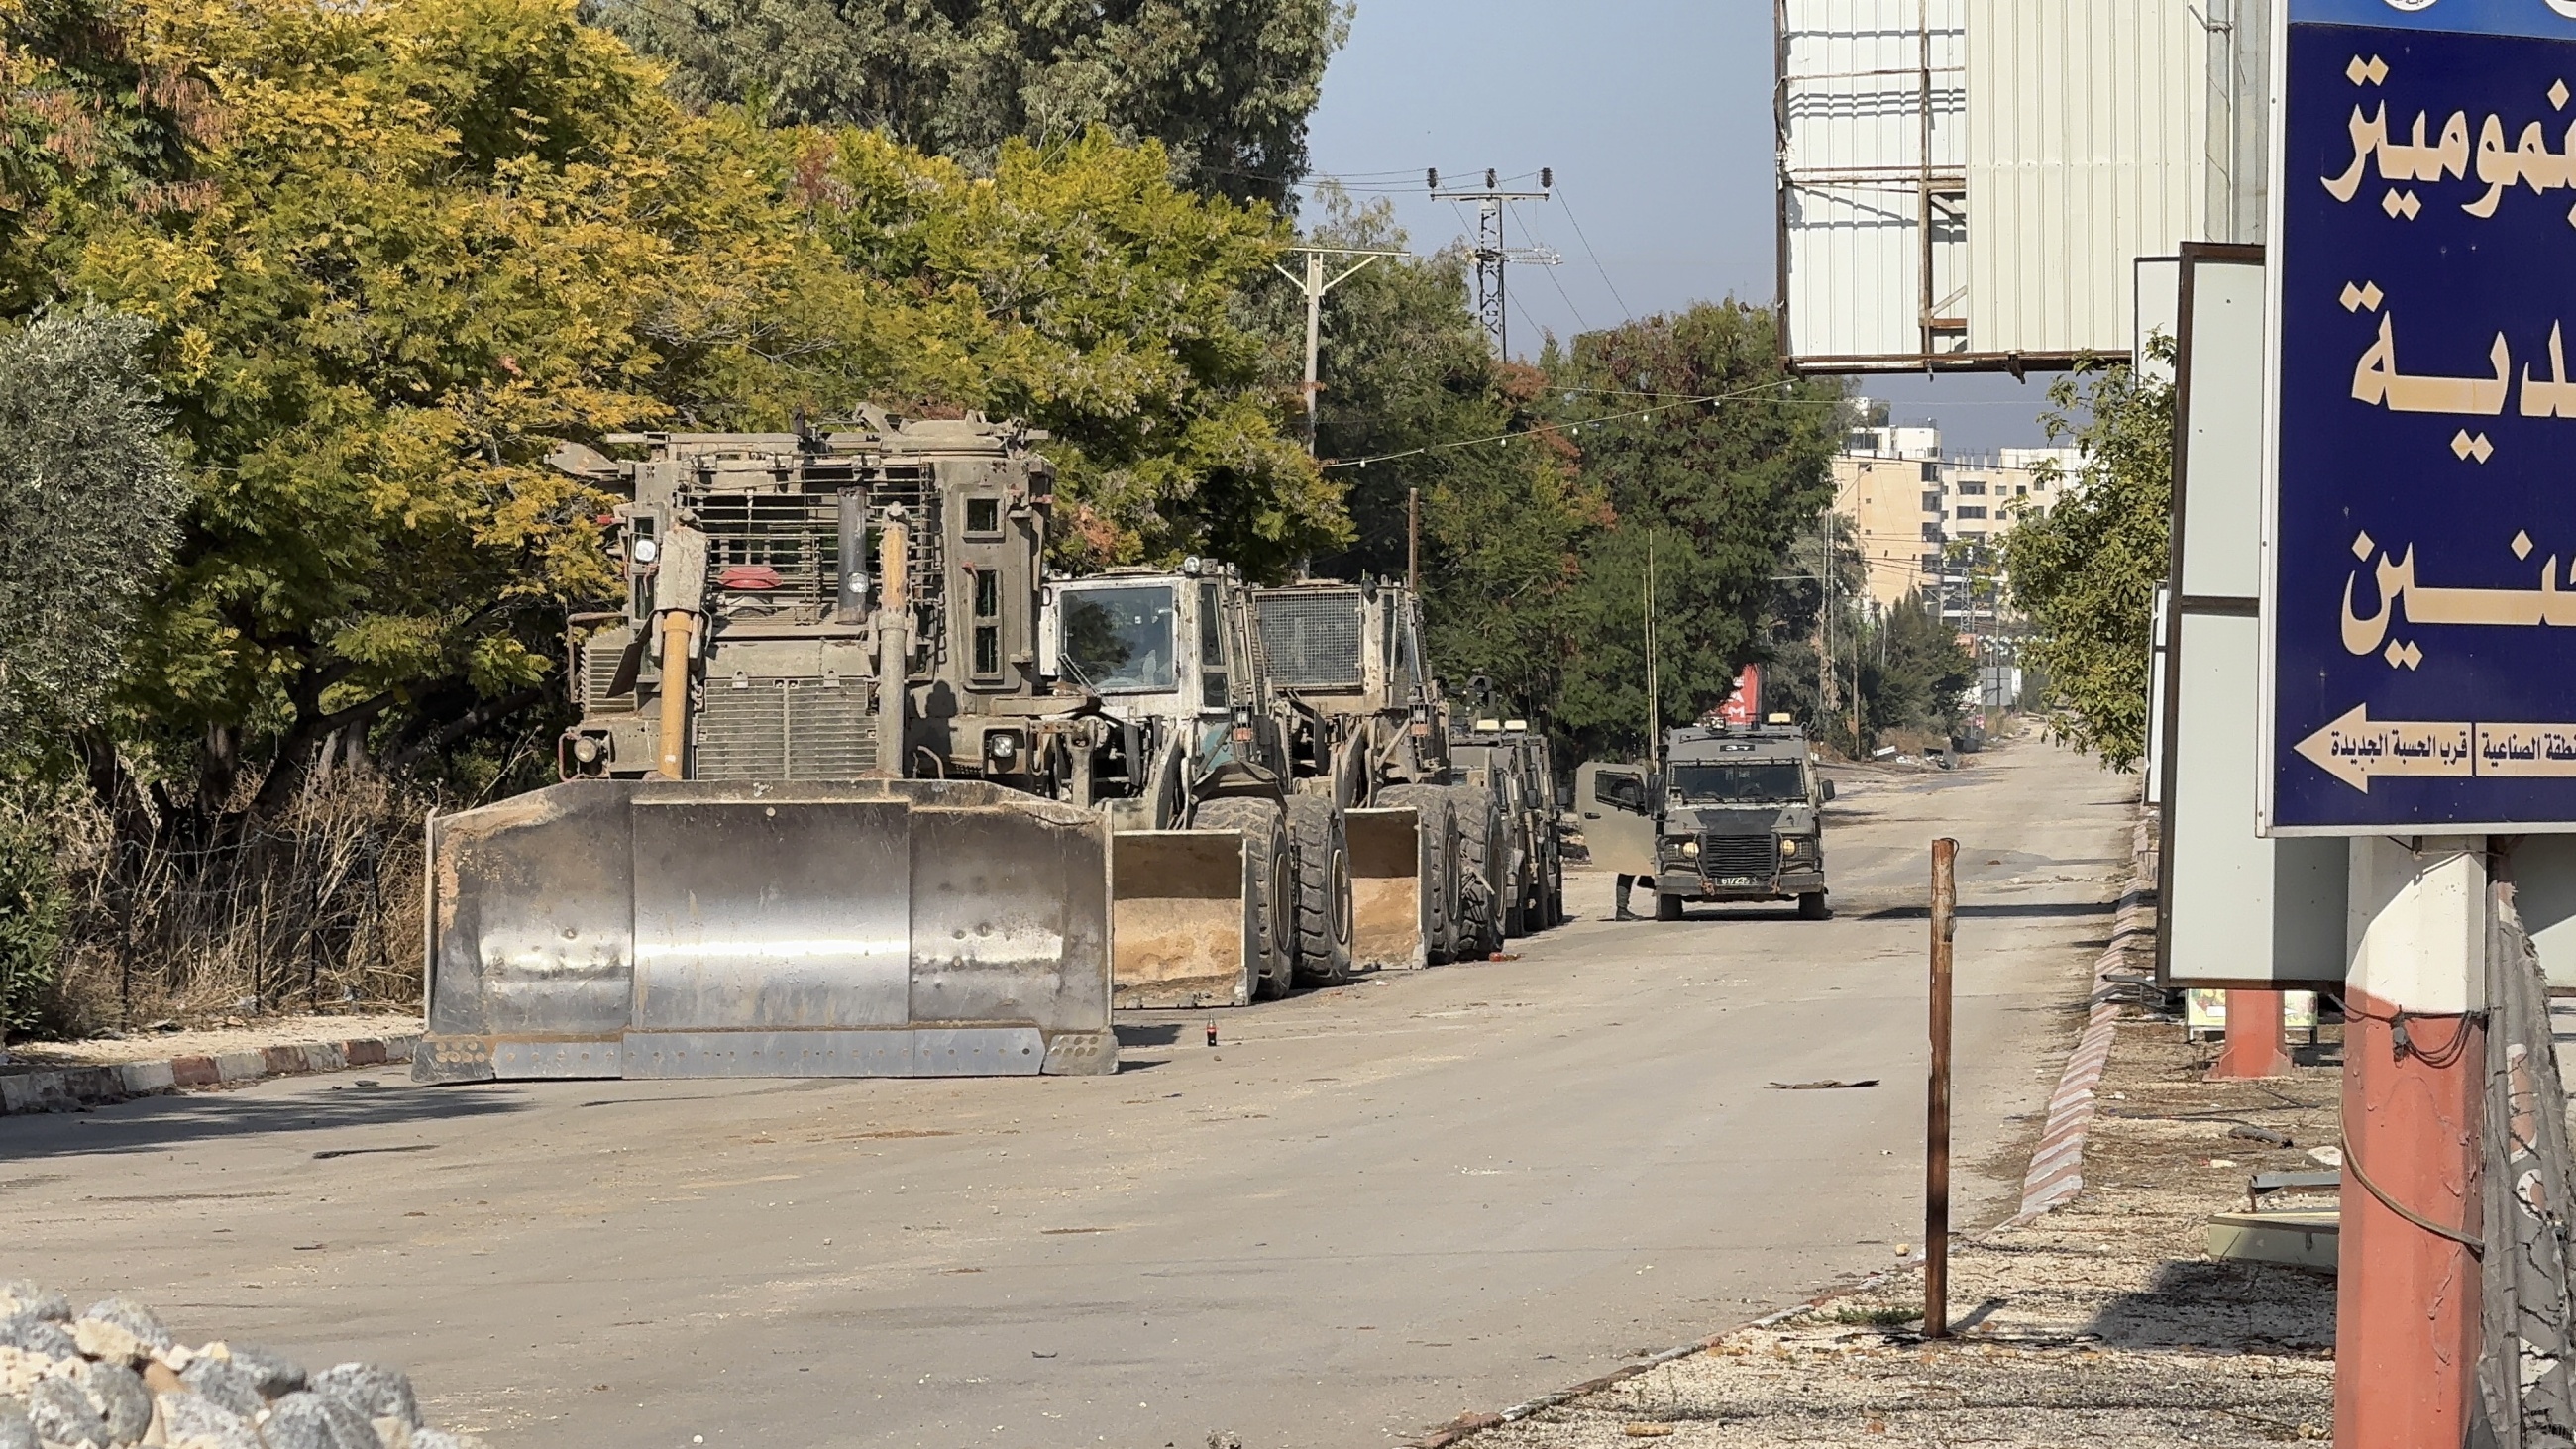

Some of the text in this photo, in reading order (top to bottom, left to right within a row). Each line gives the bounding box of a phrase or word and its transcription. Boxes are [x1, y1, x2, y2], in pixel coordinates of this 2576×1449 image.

[2340, 529, 2576, 672] نين
[2330, 730, 2389, 766] الجديدة
[2391, 729, 2436, 766] الحسبة
[2439, 730, 2468, 766] قرب
[2481, 732, 2541, 768] الصناعية
